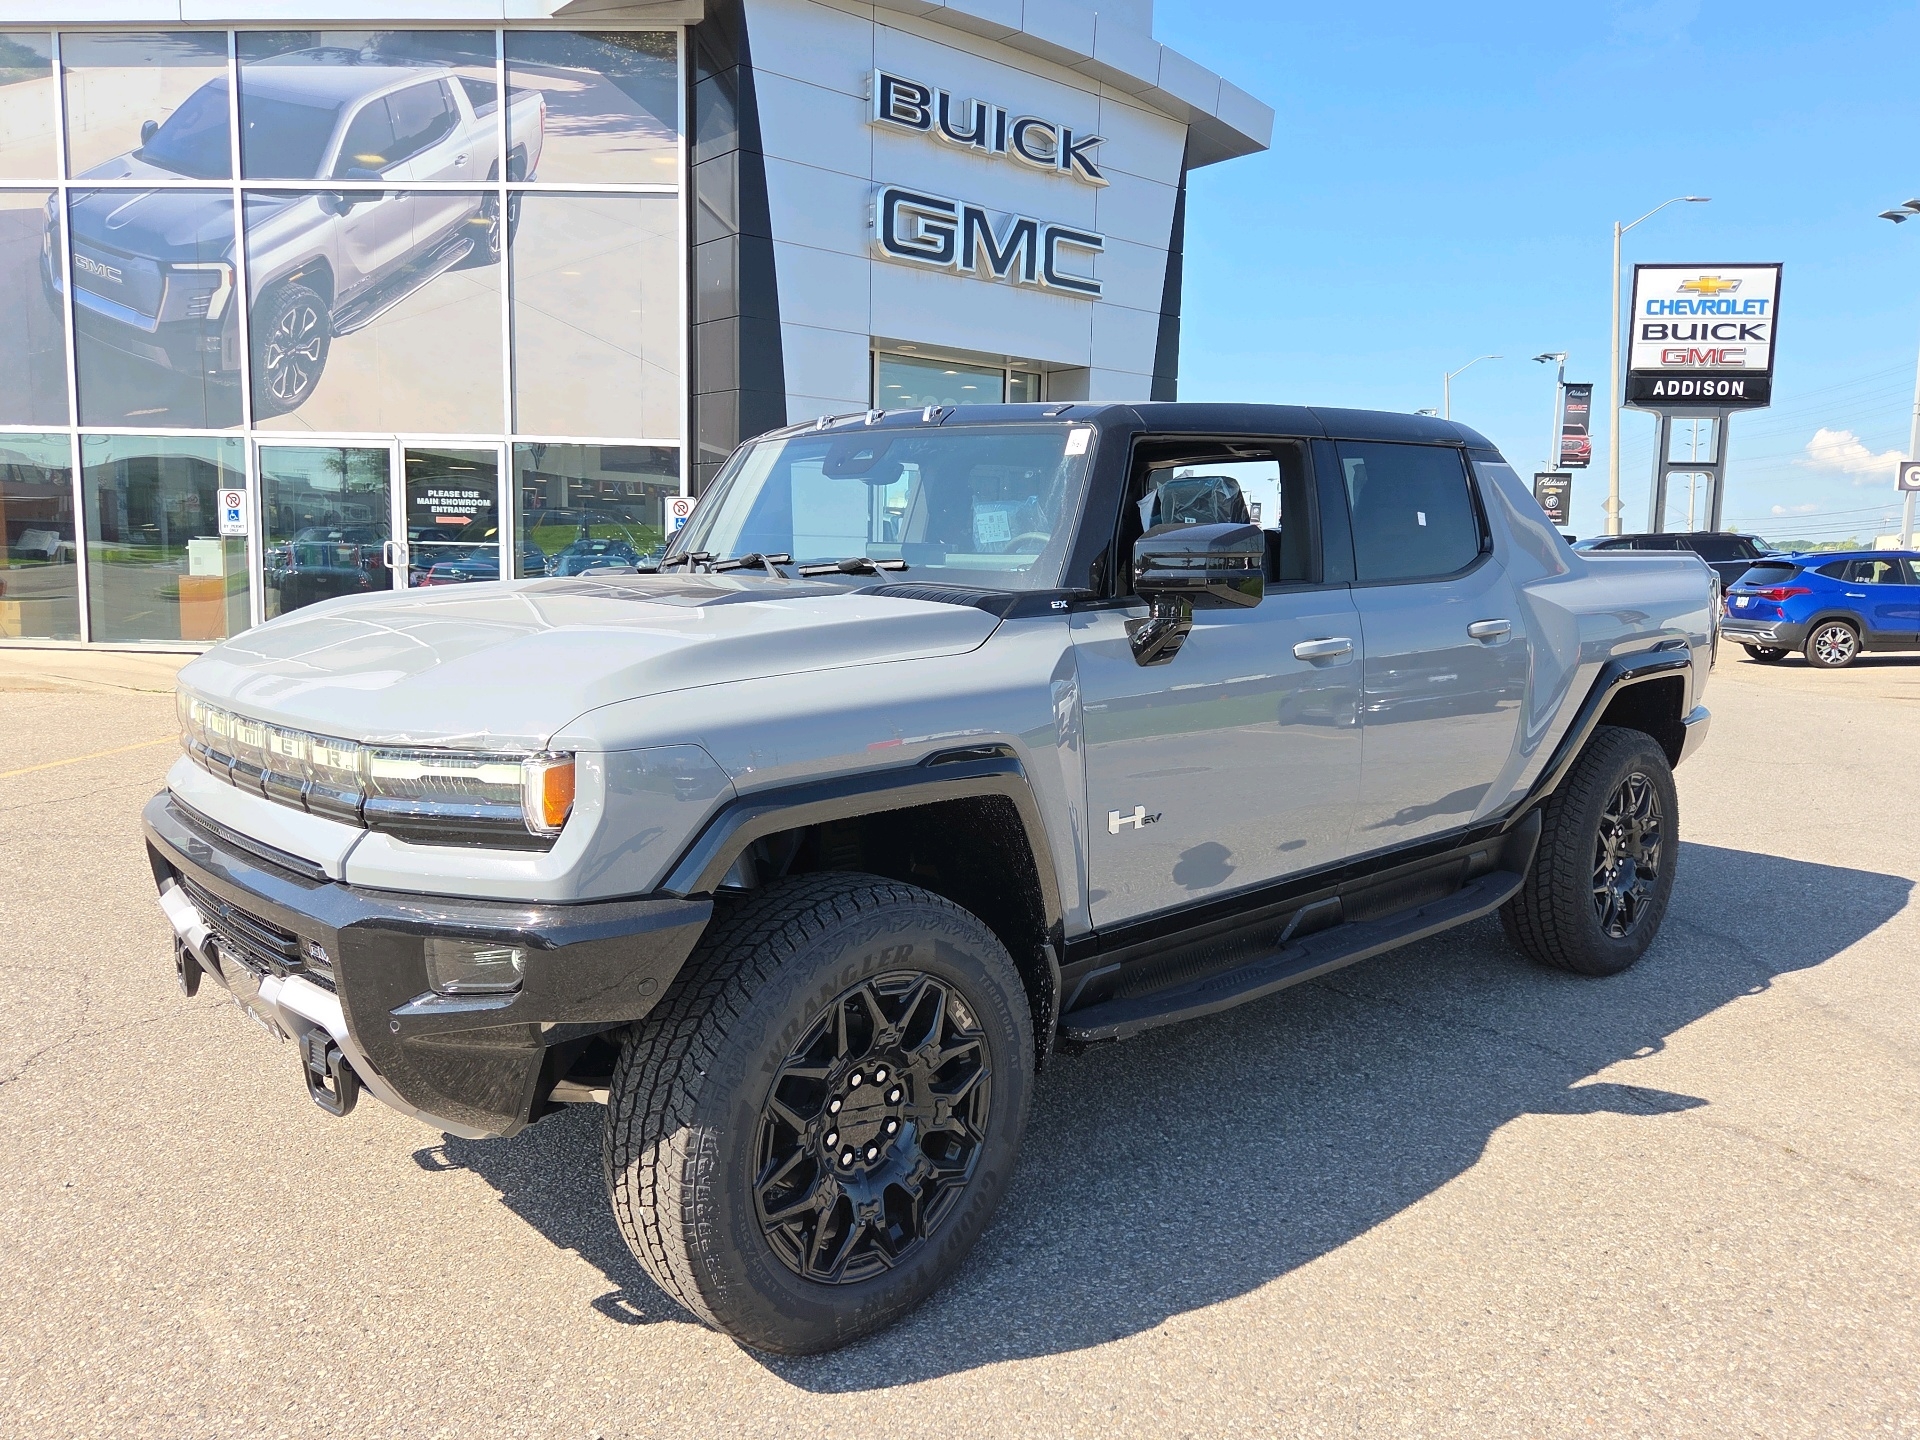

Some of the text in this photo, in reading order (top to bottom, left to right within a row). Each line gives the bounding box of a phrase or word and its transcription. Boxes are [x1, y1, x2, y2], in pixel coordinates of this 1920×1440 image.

[869, 67, 1110, 187] BUICK
[871, 183, 1105, 300] GMC
[74, 253, 123, 286] GMC
[1645, 299, 1769, 317] CHEVROLET
[1641, 322, 1767, 342] BUICK
[1661, 347, 1748, 367] GMC
[1652, 380, 1745, 397] ADDISON
[1538, 477, 1568, 486] Addison
[416, 497, 491, 506] MAIN SHOWROOM
[427, 489, 480, 498] PLEASE USE
[430, 505, 478, 514] ENTRANCE
[179, 699, 342, 768] MMER
[308, 942, 332, 964] GM
[760, 944, 915, 1074] WRANGLER
[978, 972, 1020, 1070] TERRITORY AT
